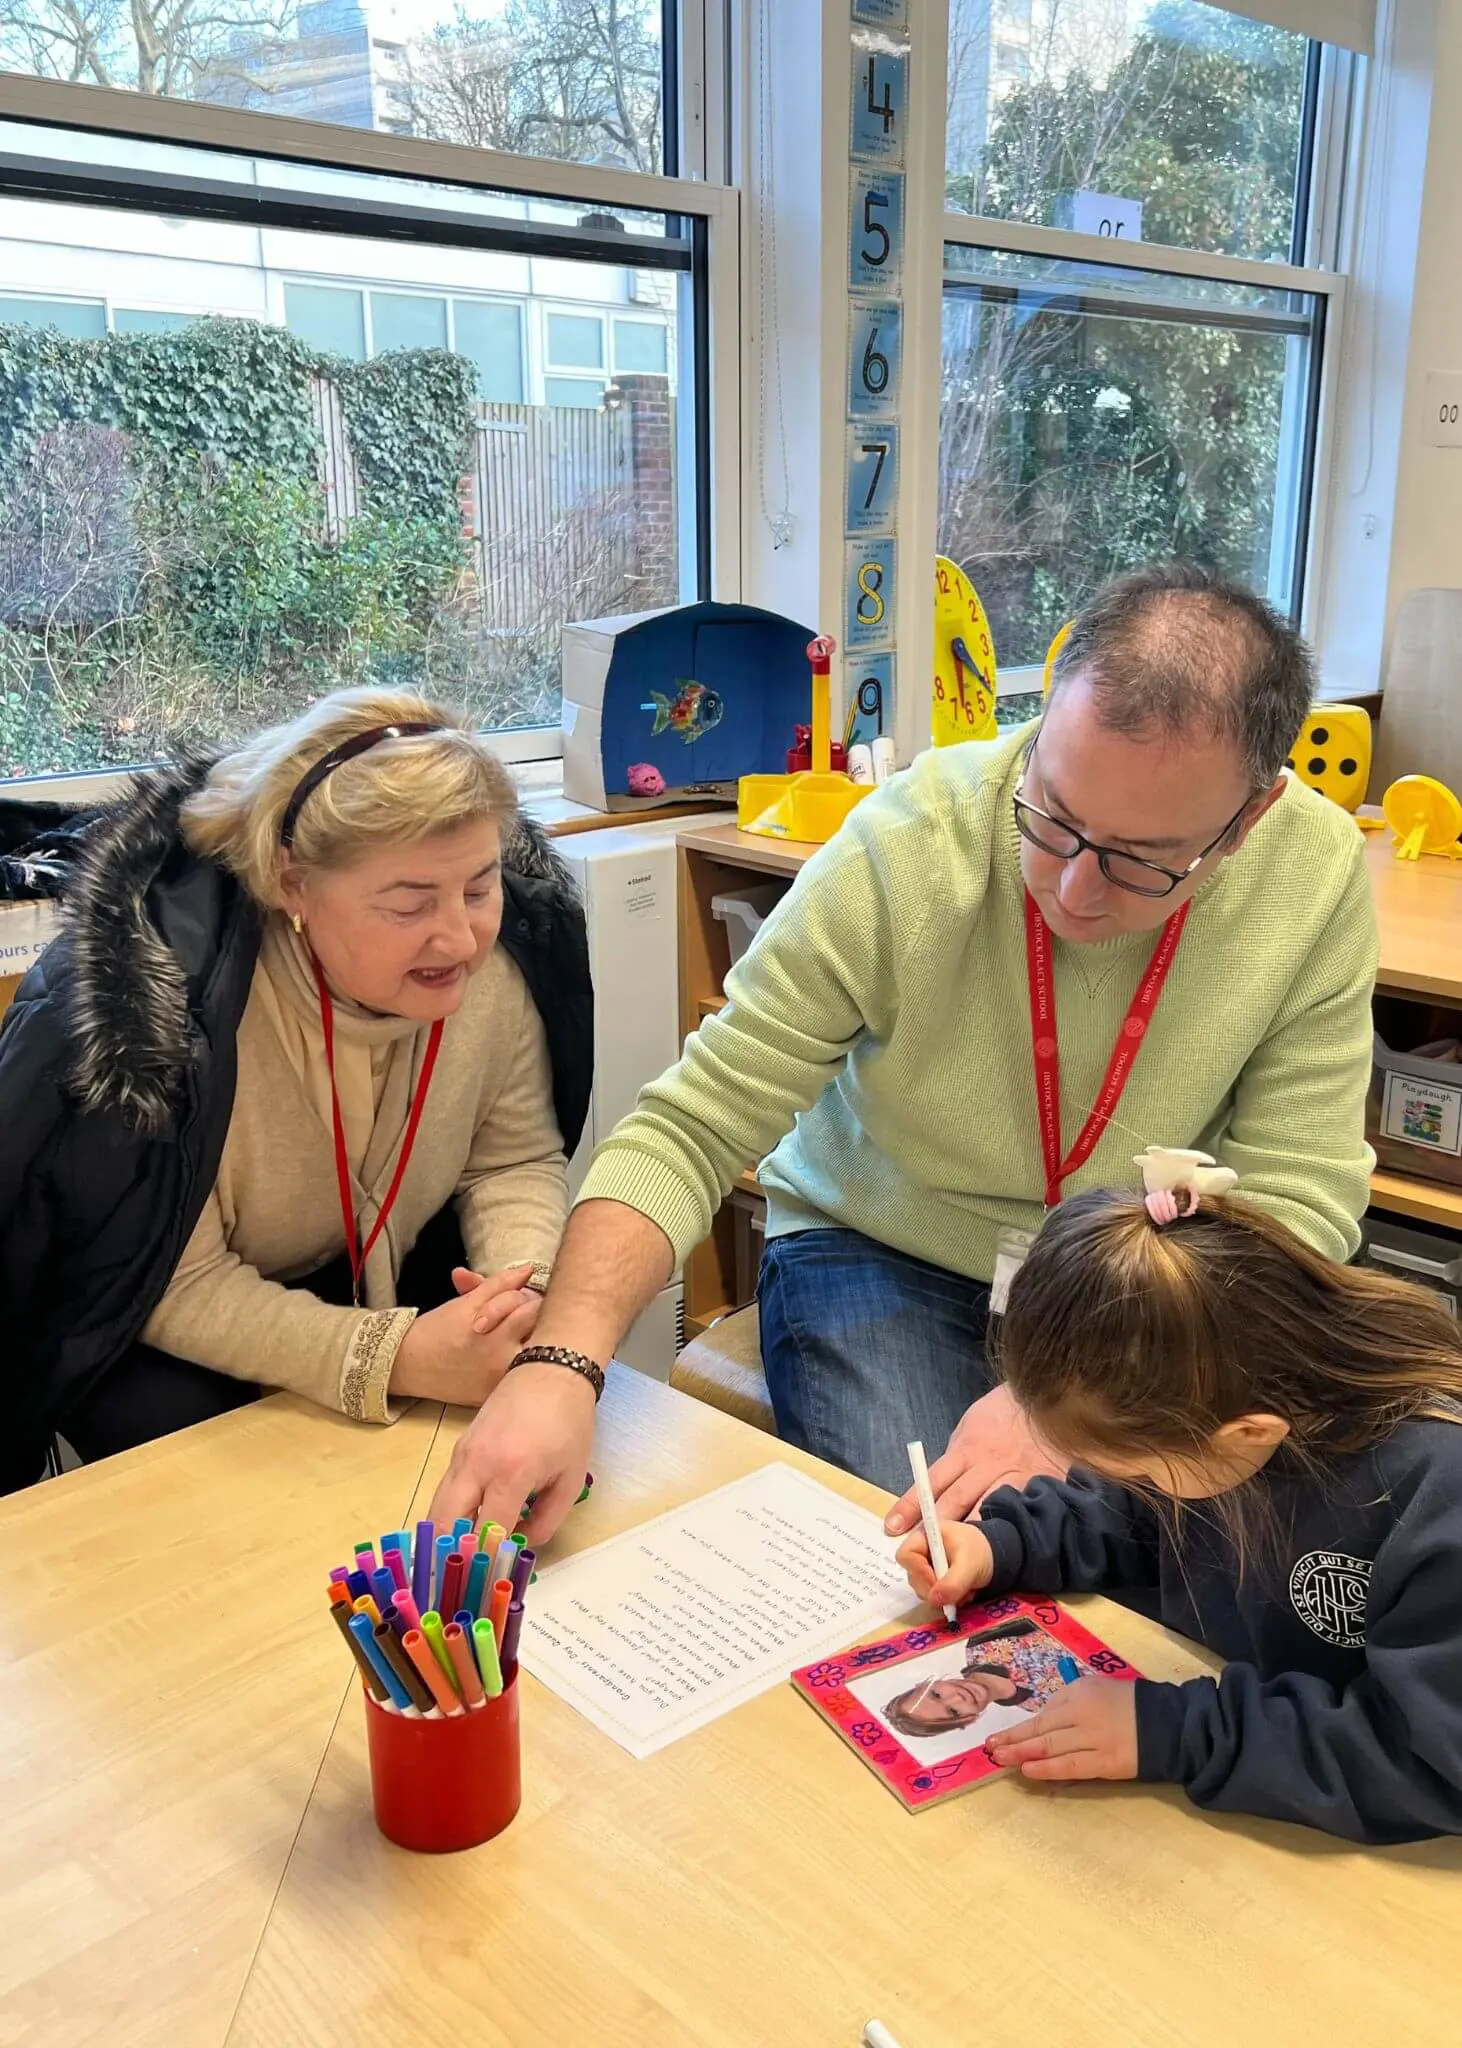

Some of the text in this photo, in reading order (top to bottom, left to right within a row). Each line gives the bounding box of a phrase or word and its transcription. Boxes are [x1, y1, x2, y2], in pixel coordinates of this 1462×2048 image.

[868, 57, 895, 133] 4
[861, 191, 889, 266] 5
[862, 327, 889, 394] 6
[862, 445, 887, 509] 7
[857, 562, 885, 625] 8
[936, 569, 950, 594] 12
[955, 577, 963, 600] 1
[968, 598, 979, 622] 2
[980, 633, 989, 656] 3
[858, 678, 882, 735] 9
[935, 676, 944, 700] 8
[950, 697, 958, 720] 7
[977, 690, 986, 713] 5
[965, 701, 975, 725] 6
[1034, 912, 1048, 1020] IBSTOCK PLACE SCHOOL
[1141, 966, 1161, 1004] IBSTOCK
[1157, 935, 1173, 965] PLACE
[1043, 1071, 1052, 1109] IBSTOCK
[1080, 1051, 1129, 1151] IBSTOCK PLACE SCHOOL
[1401, 1082, 1453, 1103] Playdough
[1046, 1111, 1055, 1139] PLACE
[1292, 1554, 1367, 1646] INCIT QUI SE VINCIT QUI SE
[527, 1620, 630, 1700] Grandparents' Day Questions
